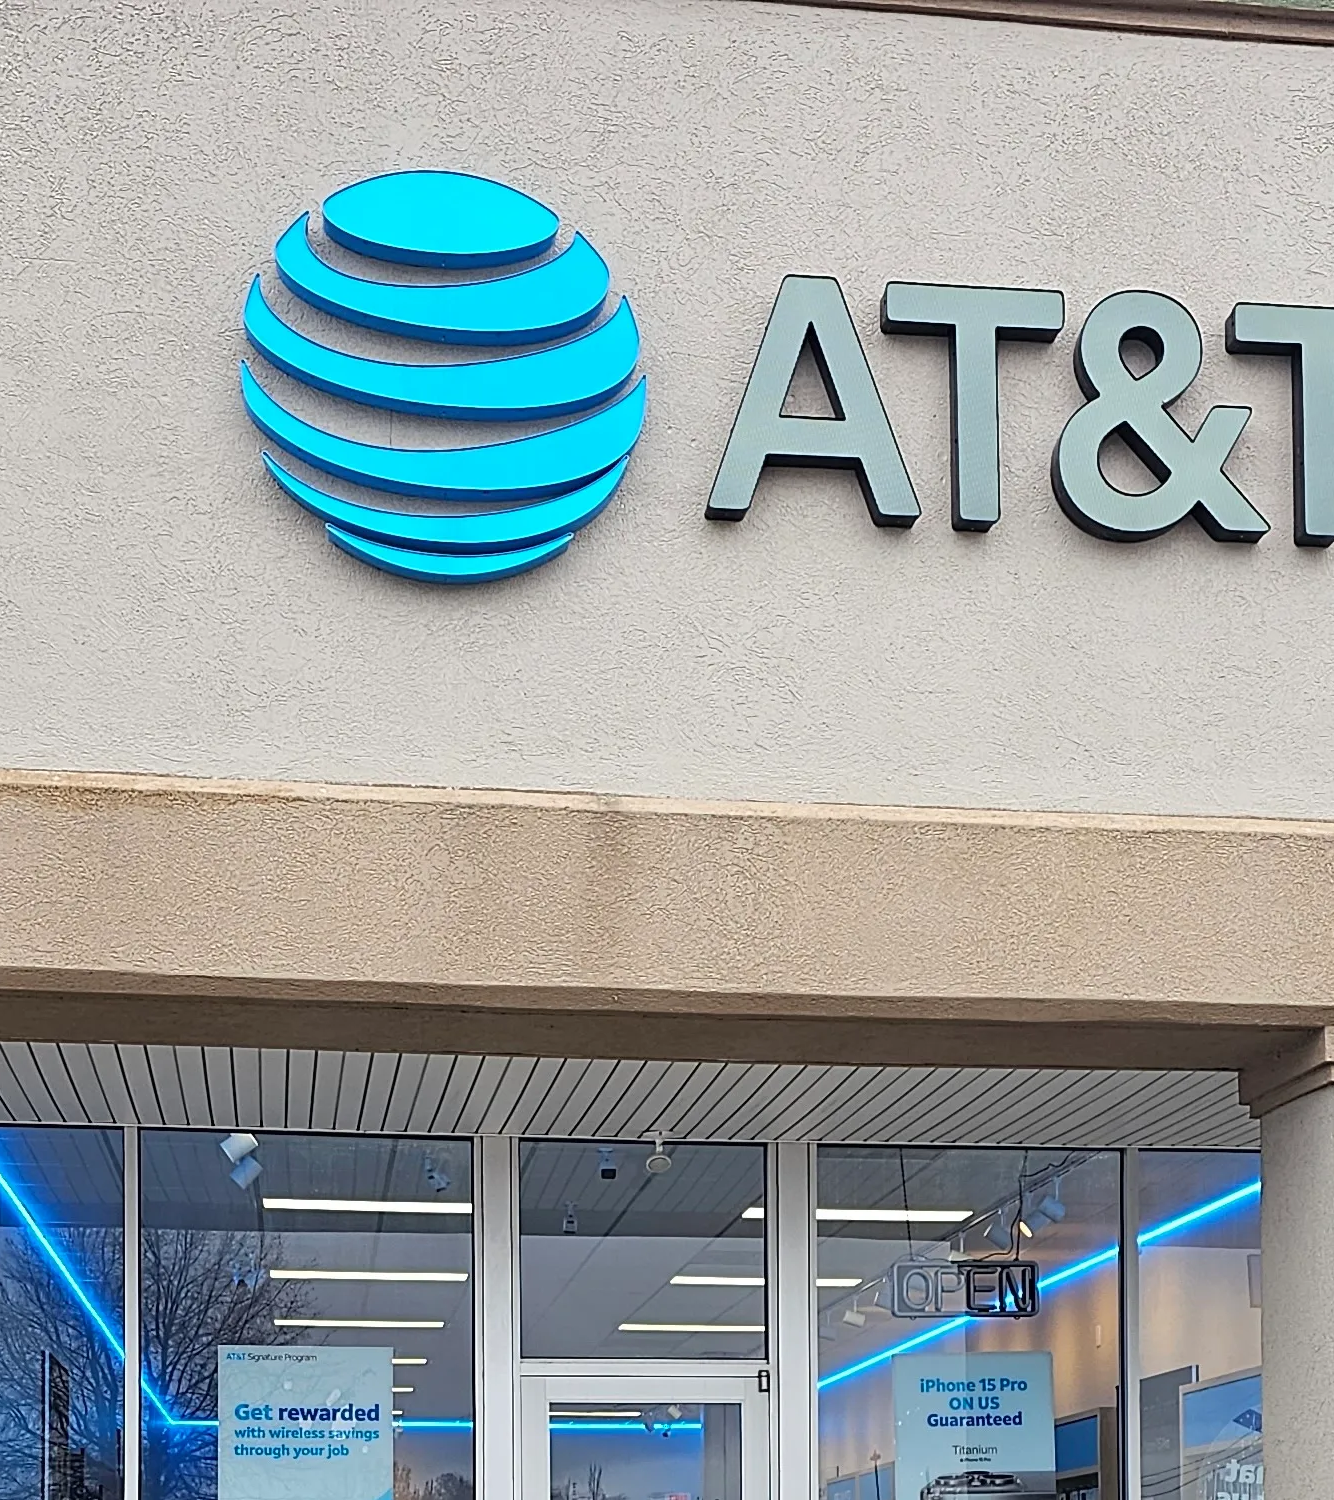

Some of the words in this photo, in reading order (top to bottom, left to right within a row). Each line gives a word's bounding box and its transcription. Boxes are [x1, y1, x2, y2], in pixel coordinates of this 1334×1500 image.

[903, 1266, 1031, 1311] OPEN
[226, 1353, 246, 1361] AT&T
[248, 1353, 283, 1363] Signature
[285, 1353, 317, 1363] Program
[920, 1378, 976, 1392] iPhone
[979, 1379, 996, 1391] 15
[1000, 1378, 1027, 1391] Pro
[949, 1397, 973, 1410] ON
[978, 1397, 1000, 1410] US
[234, 1403, 273, 1421] Get
[278, 1403, 380, 1422] rewarded
[927, 1411, 1022, 1427] Guaranteed
[234, 1426, 266, 1439] with
[268, 1426, 325, 1439] wireless
[329, 1427, 380, 1442] savings
[234, 1444, 290, 1459] through
[293, 1446, 325, 1459] your
[327, 1444, 349, 1459] job
[952, 1444, 997, 1455] Titanium
